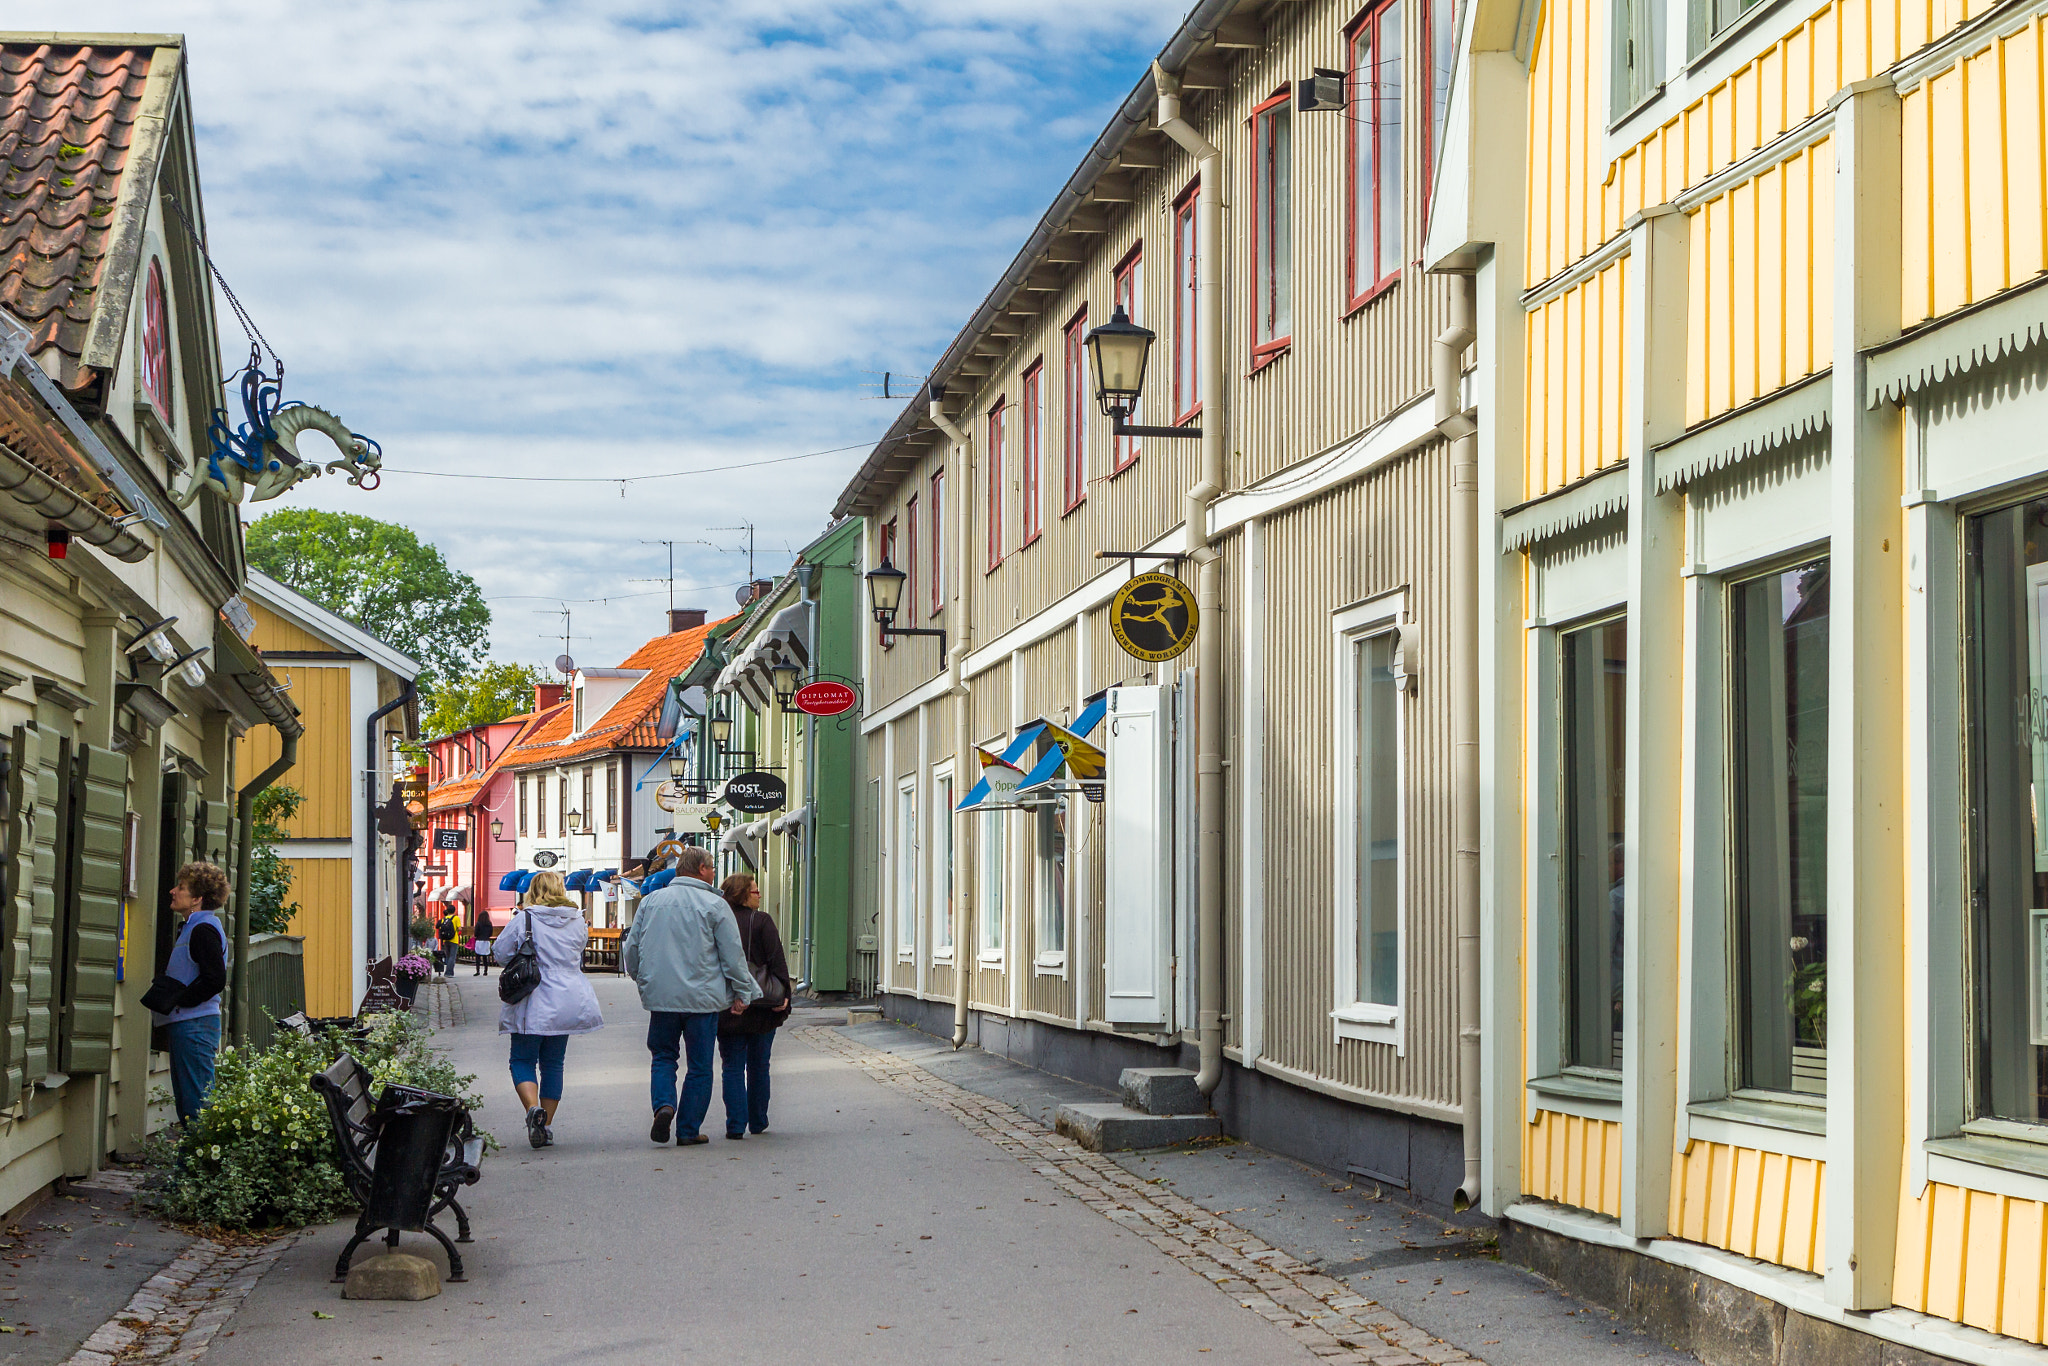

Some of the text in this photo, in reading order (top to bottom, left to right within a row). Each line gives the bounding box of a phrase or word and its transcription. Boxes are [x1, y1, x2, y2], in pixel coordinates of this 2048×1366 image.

[1124, 575, 1183, 592] BLOMMOGRAM
[1114, 622, 1196, 659] FLOWERS WORLD WIDE
[801, 691, 849, 699] DIPLOMAT
[730, 784, 760, 794] ROST
[995, 780, 1020, 792] Öppe
[675, 806, 714, 814] SALONGE
[442, 834, 458, 842] Cri
